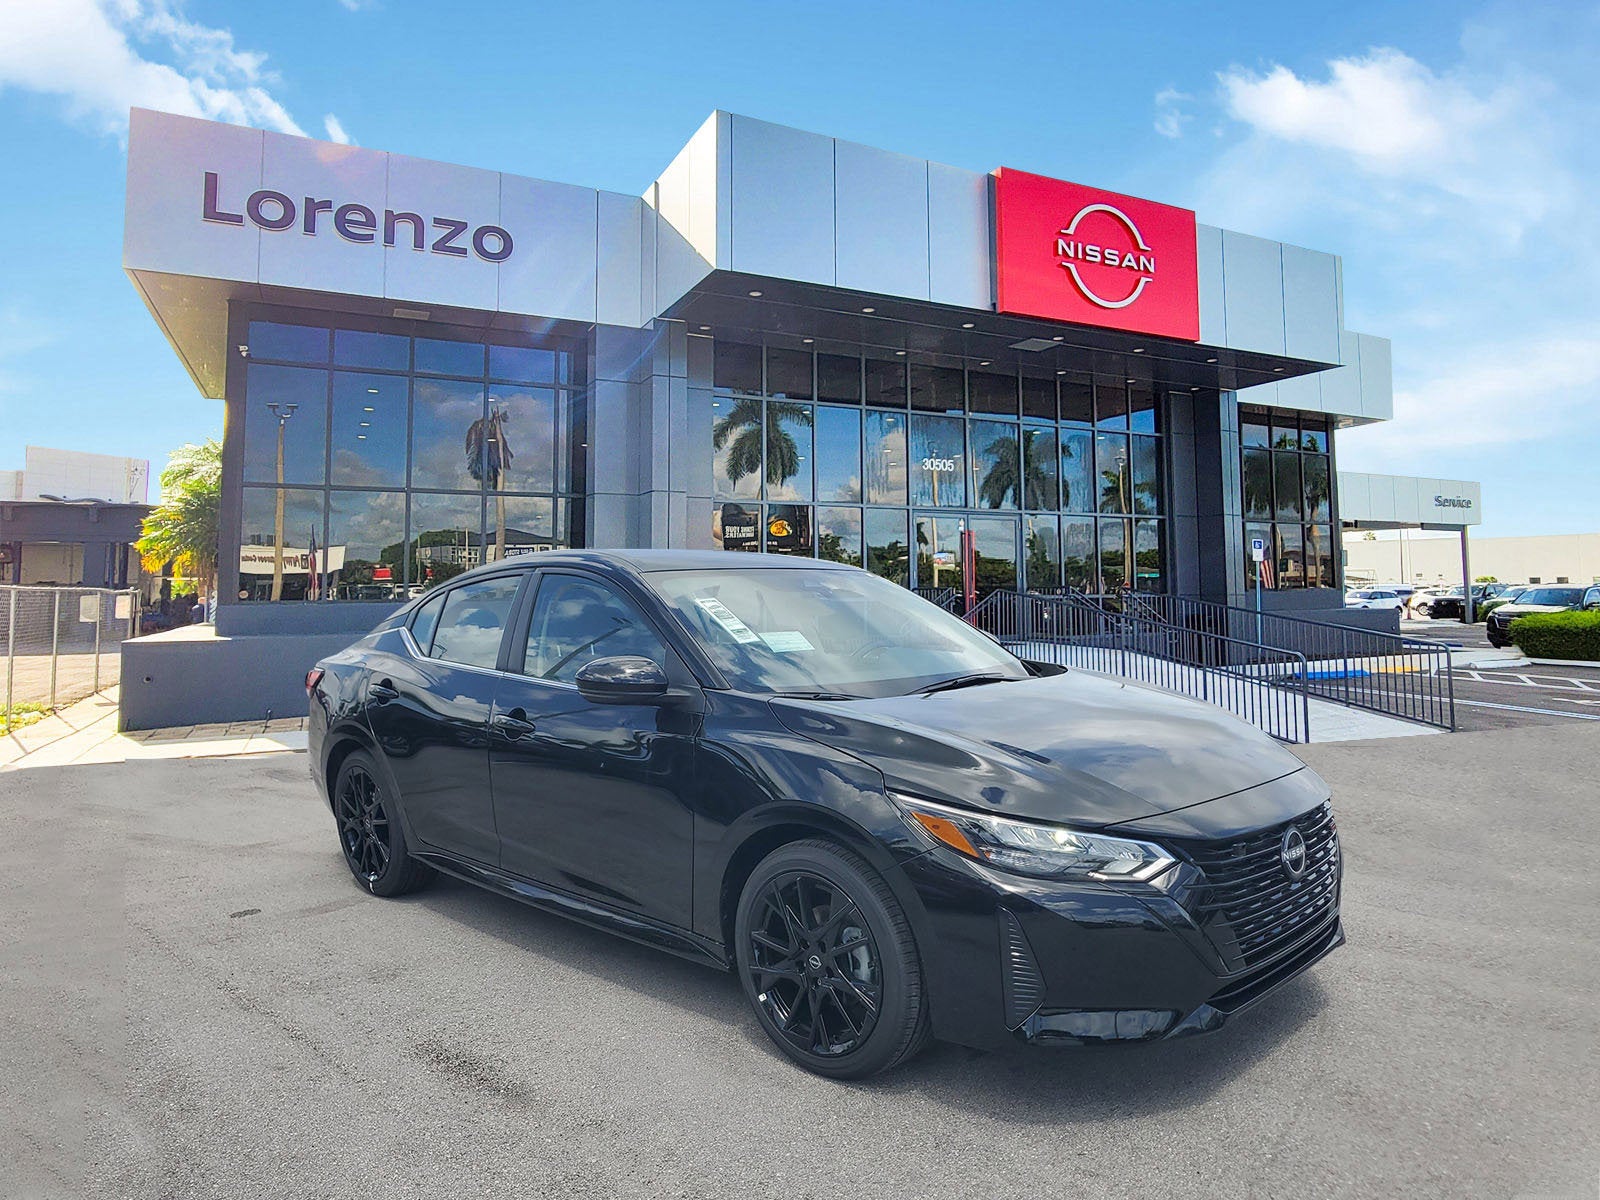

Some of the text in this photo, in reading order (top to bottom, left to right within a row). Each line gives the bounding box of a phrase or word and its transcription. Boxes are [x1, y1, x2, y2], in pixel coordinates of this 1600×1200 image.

[203, 171, 514, 262] Lorenzo
[1057, 238, 1155, 273] NISSAN
[922, 457, 955, 472] 30505
[1434, 495, 1472, 509] Service
